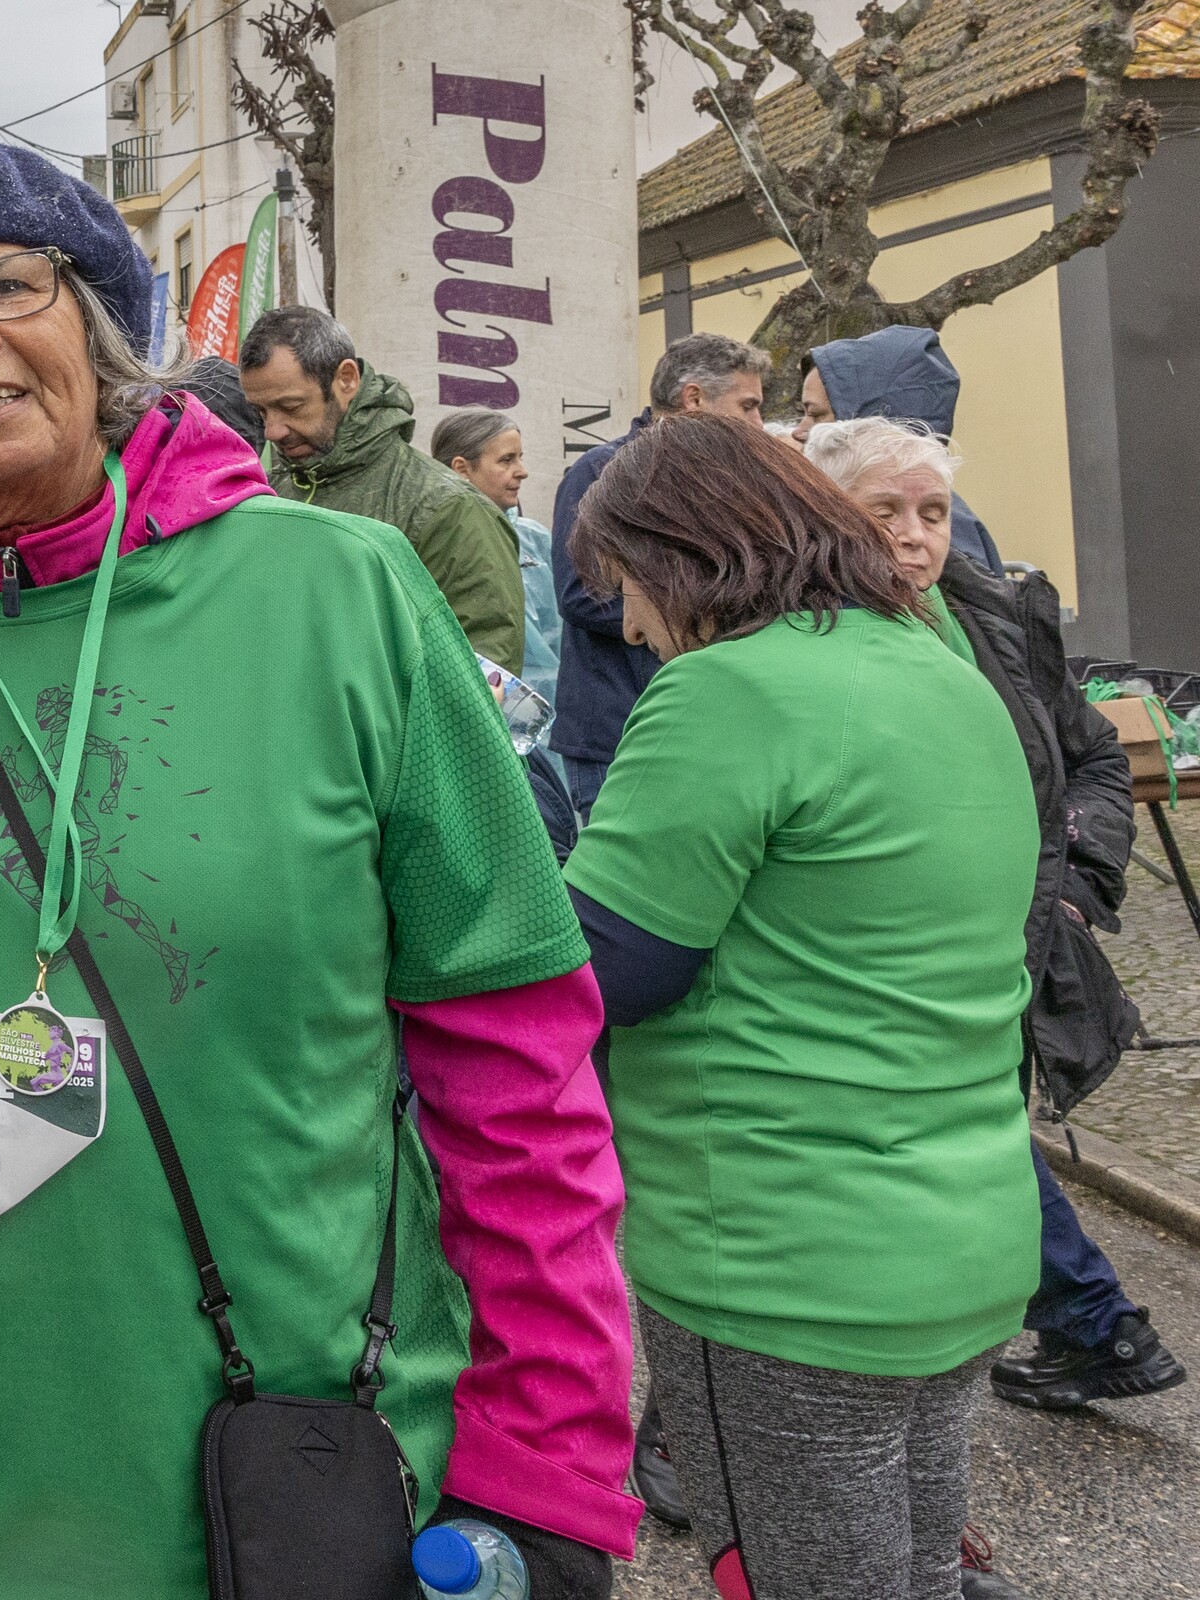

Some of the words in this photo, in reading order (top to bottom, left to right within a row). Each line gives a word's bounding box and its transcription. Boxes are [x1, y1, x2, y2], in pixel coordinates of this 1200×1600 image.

[432, 62, 553, 409] Palm
[0, 1036, 40, 1050] SILVESTRE
[0, 1043, 35, 1057] TRILHOS
[35, 1050, 47, 1059] DE
[79, 1043, 93, 1062] 9
[75, 1062, 94, 1073] AN
[67, 1076, 95, 1088] 2025
